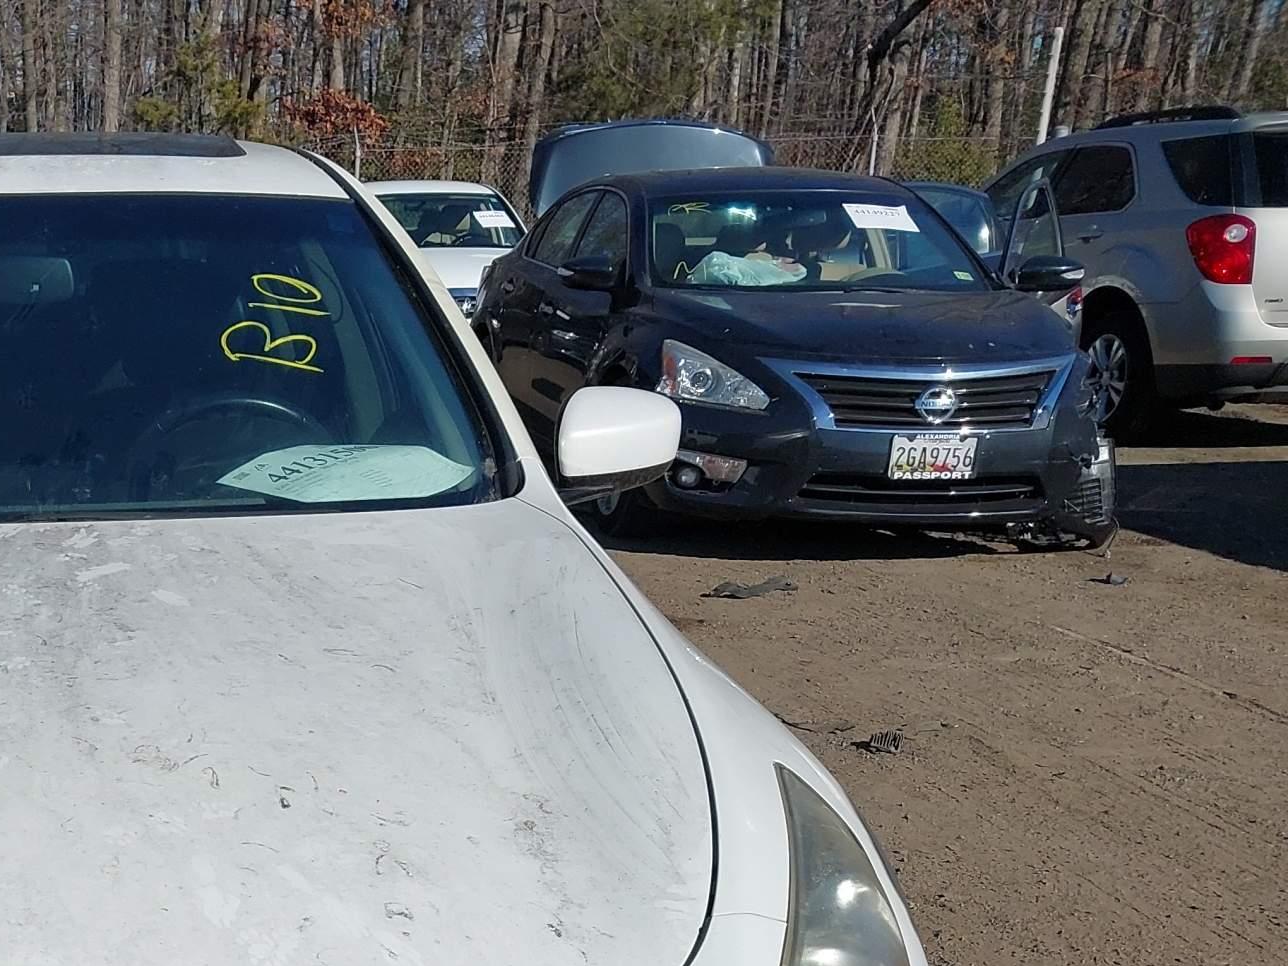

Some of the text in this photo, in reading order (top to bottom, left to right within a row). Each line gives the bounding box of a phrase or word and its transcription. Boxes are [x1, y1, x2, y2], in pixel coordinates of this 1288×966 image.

[220, 273, 332, 373] B10
[894, 446, 972, 470] 2GA9756
[893, 471, 972, 480] PASSPORT
